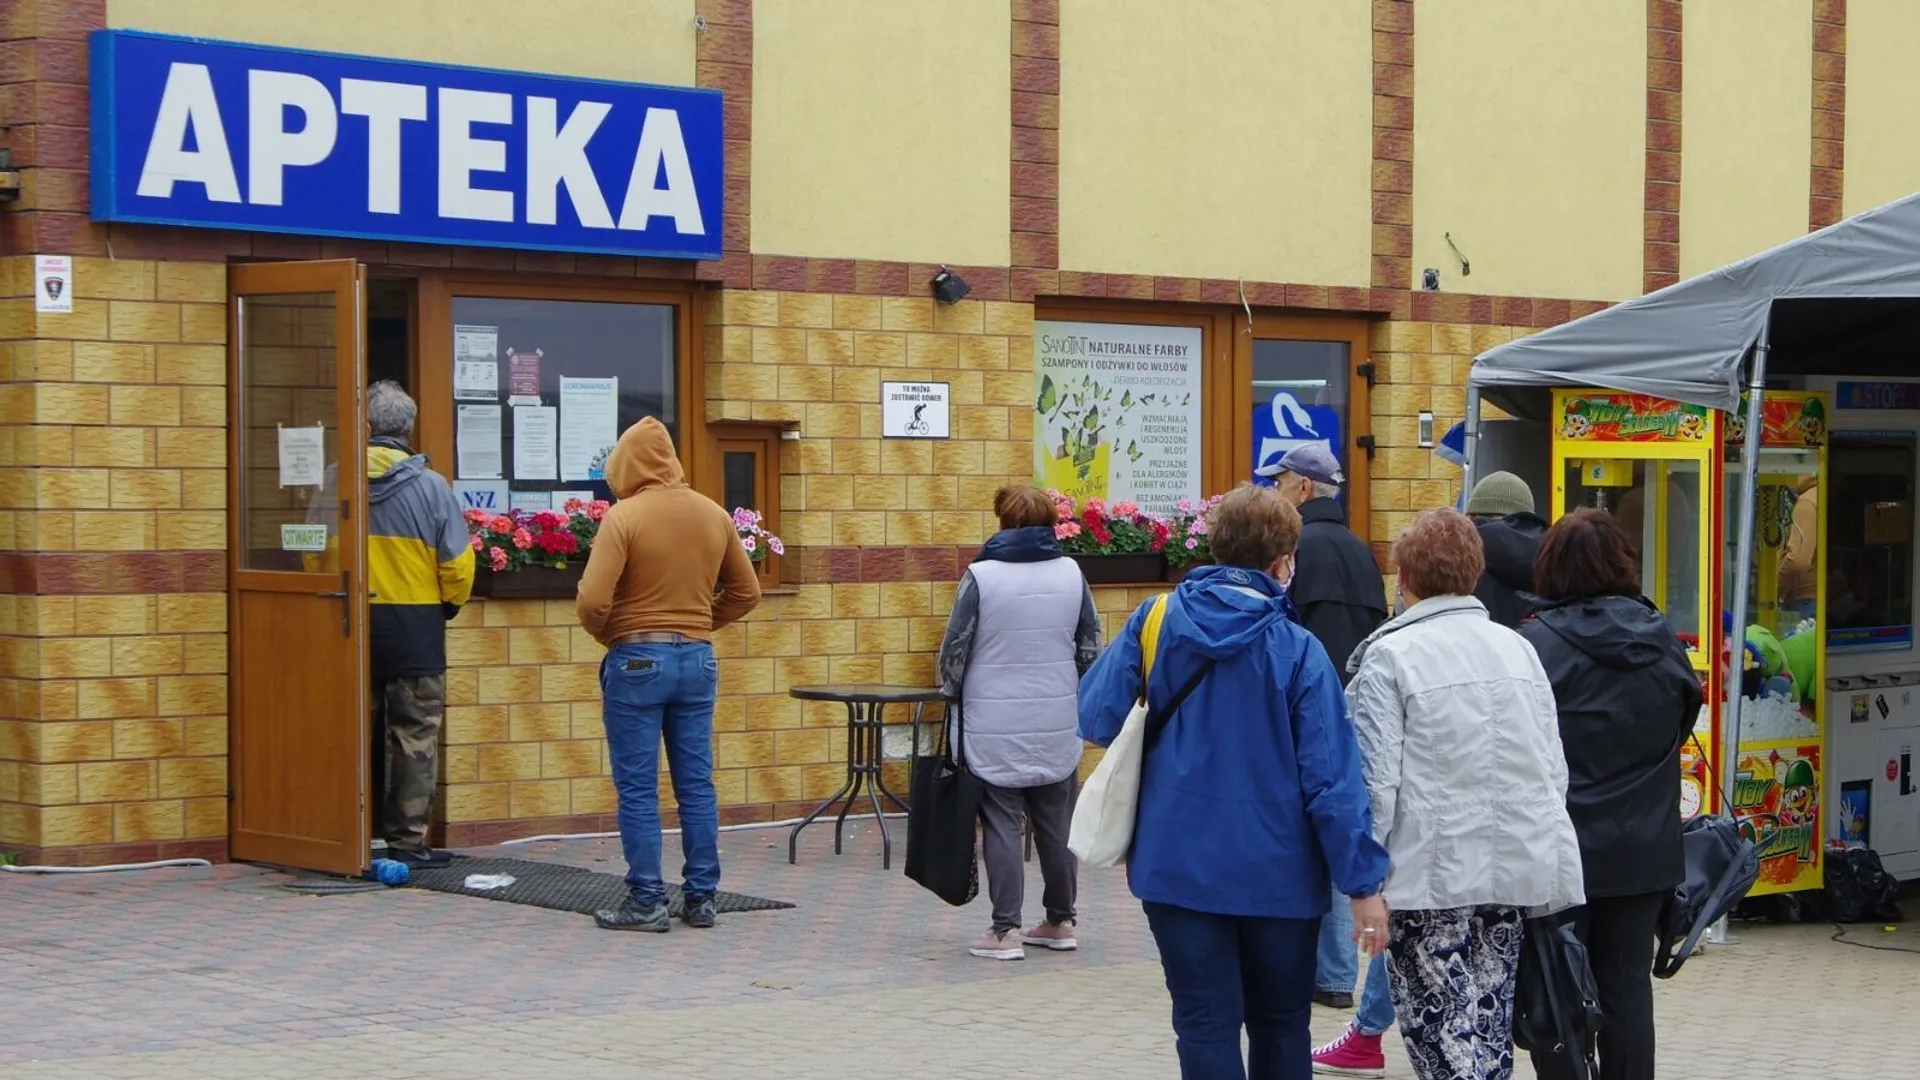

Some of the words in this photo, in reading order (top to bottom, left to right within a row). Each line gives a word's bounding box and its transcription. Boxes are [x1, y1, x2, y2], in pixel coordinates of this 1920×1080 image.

[136, 62, 706, 236] APTEKA
[1089, 341, 1151, 355] NATURALNE
[1154, 344, 1188, 356] FARBY
[1041, 357, 1089, 368] SZAMPONY
[1096, 358, 1134, 371] ODŻYWKI
[1137, 362, 1149, 371] DO
[911, 384, 931, 393] MOŻNA
[891, 393, 920, 401] ZOSTAWIĆ
[1141, 415, 1187, 425] WZMACNIAJĄ
[1144, 425, 1188, 435] REGENERUJĄ
[1141, 435, 1188, 444] USZKODZONE
[1132, 470, 1145, 478] DLA
[1134, 481, 1158, 489] KOBIET
[1160, 481, 1166, 489] W
[463, 491, 496, 509] NFZ
[284, 529, 325, 547] OTWARTE
